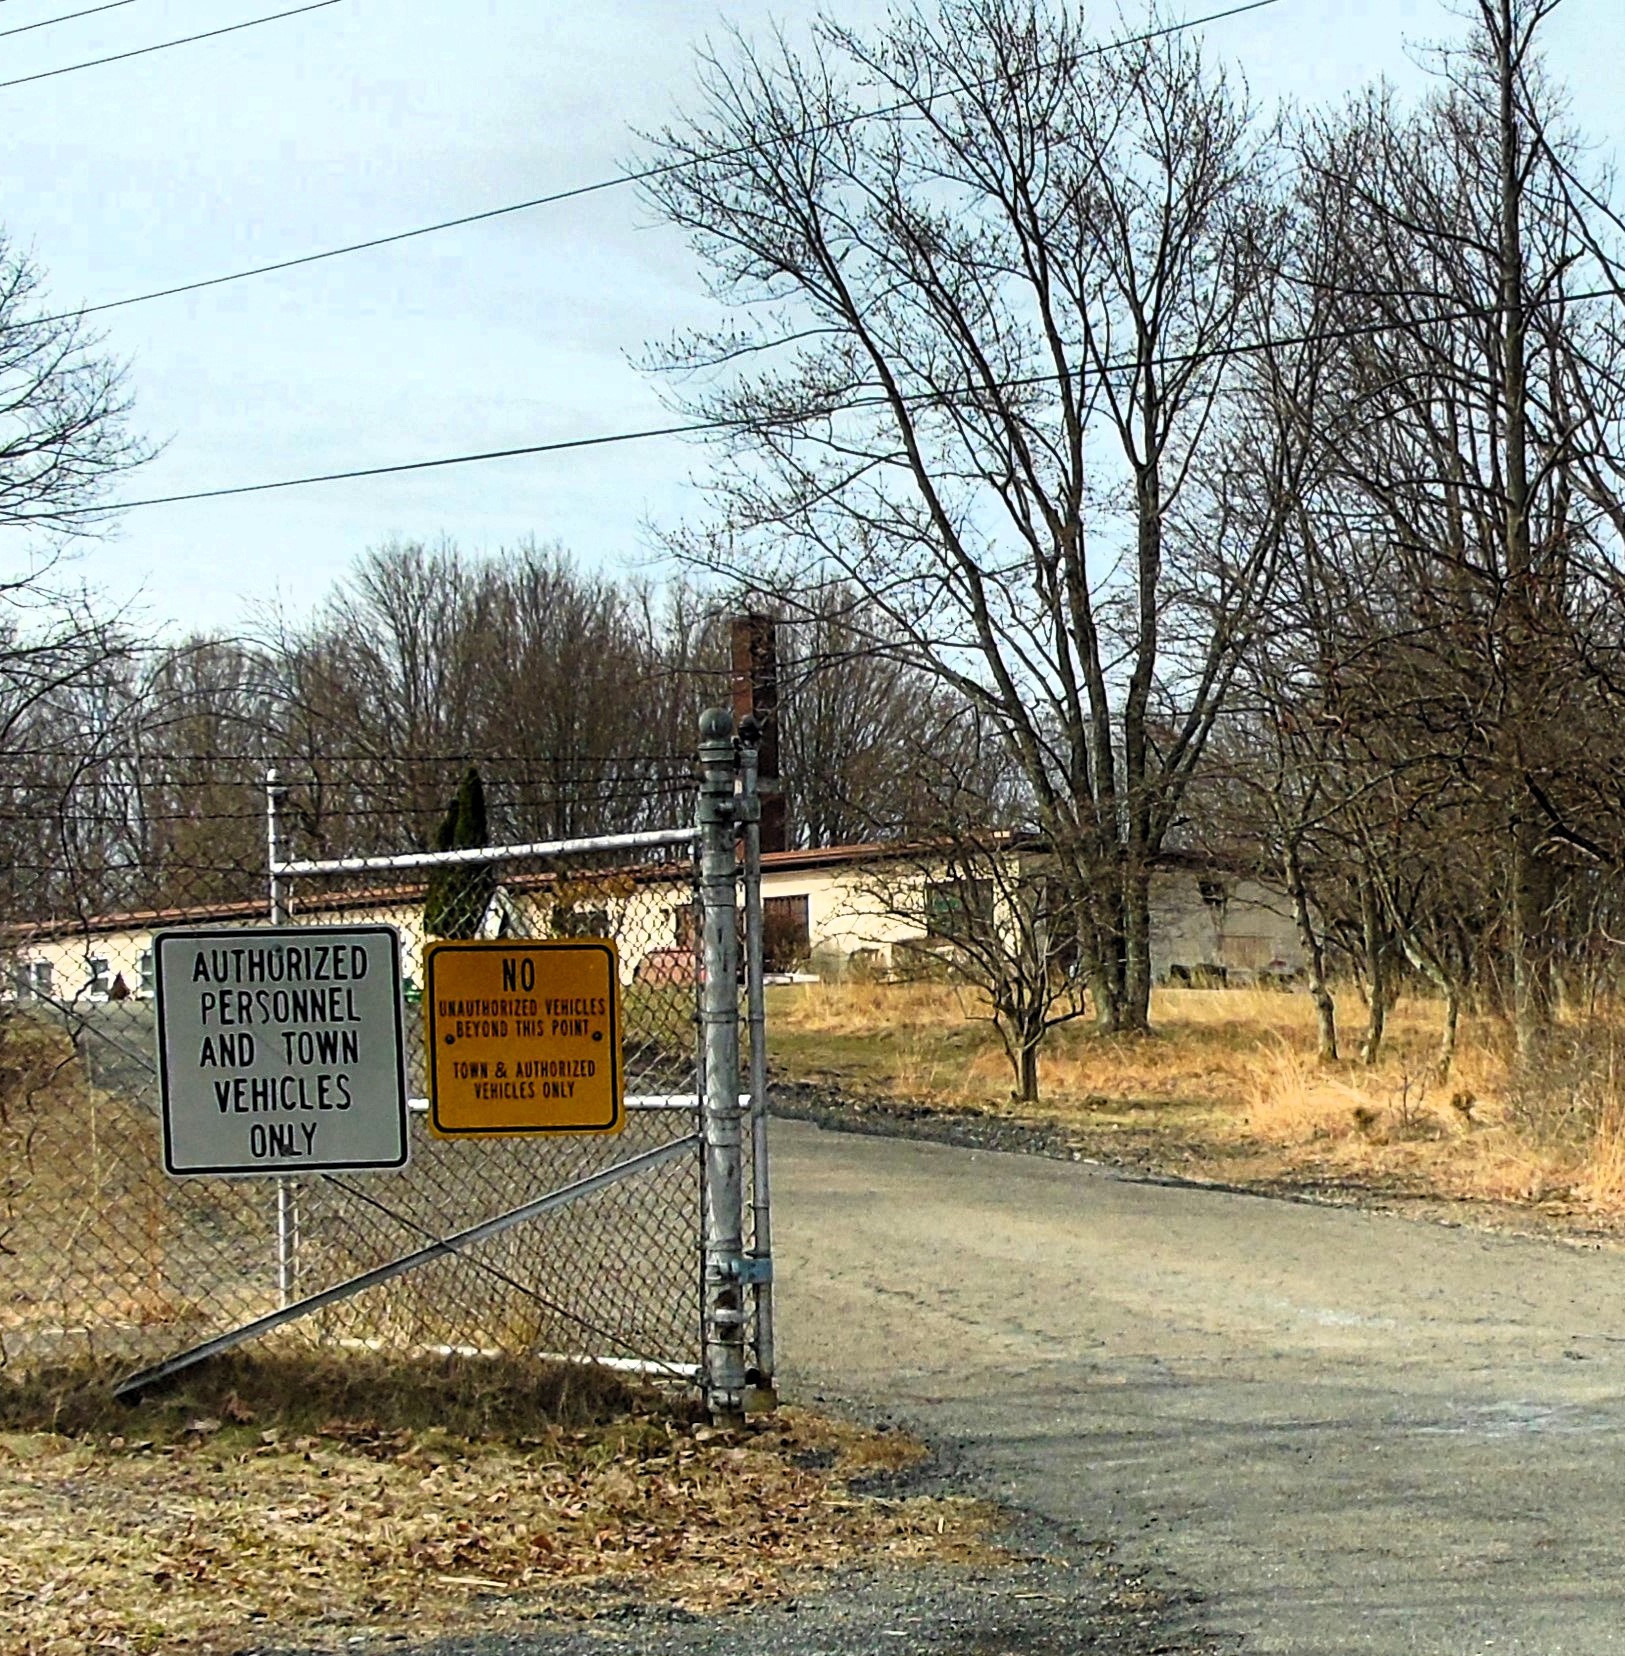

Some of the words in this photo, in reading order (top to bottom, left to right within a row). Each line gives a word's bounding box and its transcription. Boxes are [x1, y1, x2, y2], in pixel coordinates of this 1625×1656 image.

[192, 945, 368, 983] AUTHORIZED
[502, 958, 535, 992] NO
[201, 986, 361, 1025] PERSONNEL
[439, 1000, 538, 1017] UNAUTHORIZED
[545, 998, 606, 1016] VEHICLES
[456, 1020, 508, 1038] BEYOND
[516, 1020, 544, 1037] THIS
[552, 1019, 589, 1036] POINT
[200, 1033, 254, 1067] AND
[281, 1030, 358, 1065] TOWN
[453, 1061, 488, 1079] TOWN
[494, 1061, 507, 1078] &
[515, 1060, 595, 1077] AUTHORIZED
[214, 1074, 351, 1113] VEHICLES
[474, 1082, 535, 1099] VEHICLES
[543, 1081, 575, 1098] ONLY
[250, 1122, 317, 1158] ONLY
